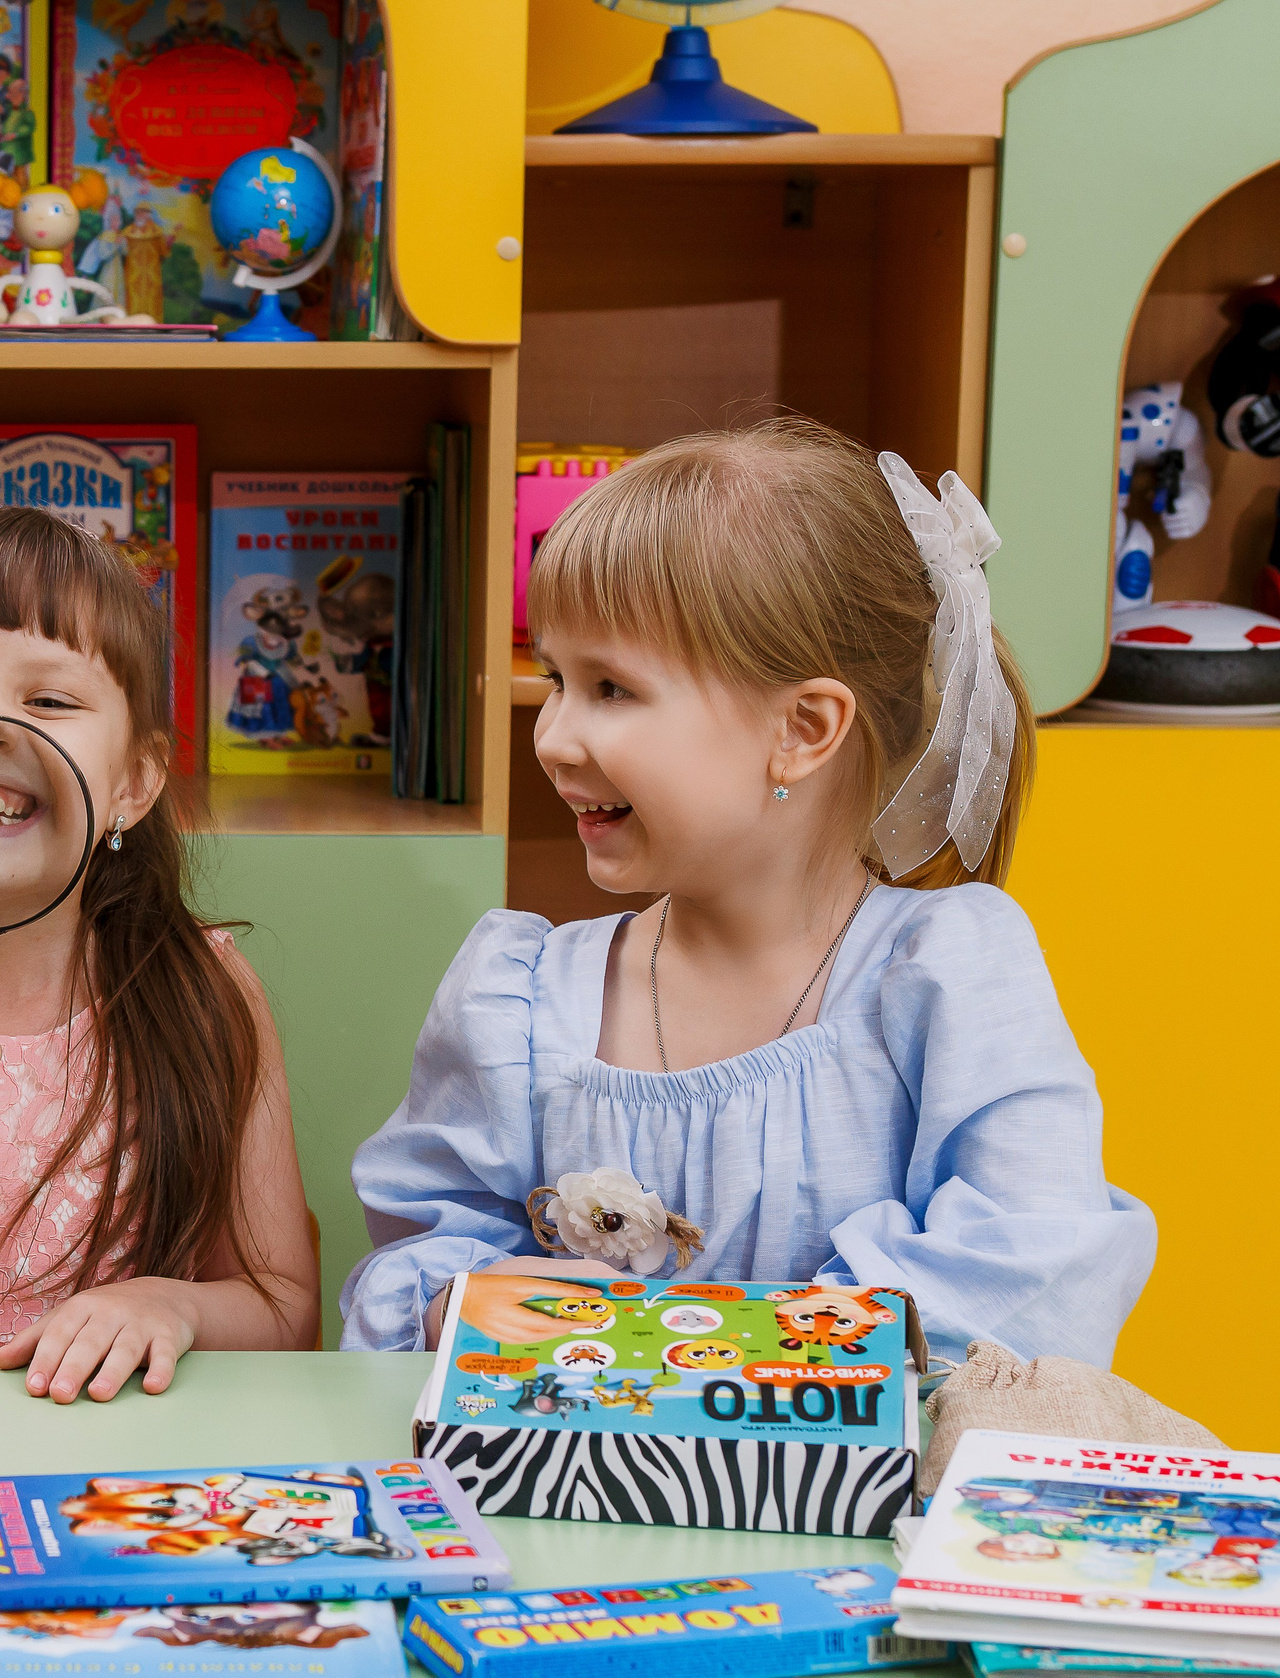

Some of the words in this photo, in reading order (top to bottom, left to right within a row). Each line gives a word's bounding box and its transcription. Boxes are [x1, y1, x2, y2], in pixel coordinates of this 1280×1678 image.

[226, 481, 300, 494] УЧЕБНИК
[286, 510, 380, 527] УРОКИ
[754, 1367, 884, 1380] ЖИВОТНЫЕ
[703, 1380, 886, 1427] ЛОТО
[375, 1462, 478, 1560] БУКВАРЬ
[208, 1581, 422, 1604] БУКВАРЬ
[474, 1603, 783, 1649] ДОМИНО
